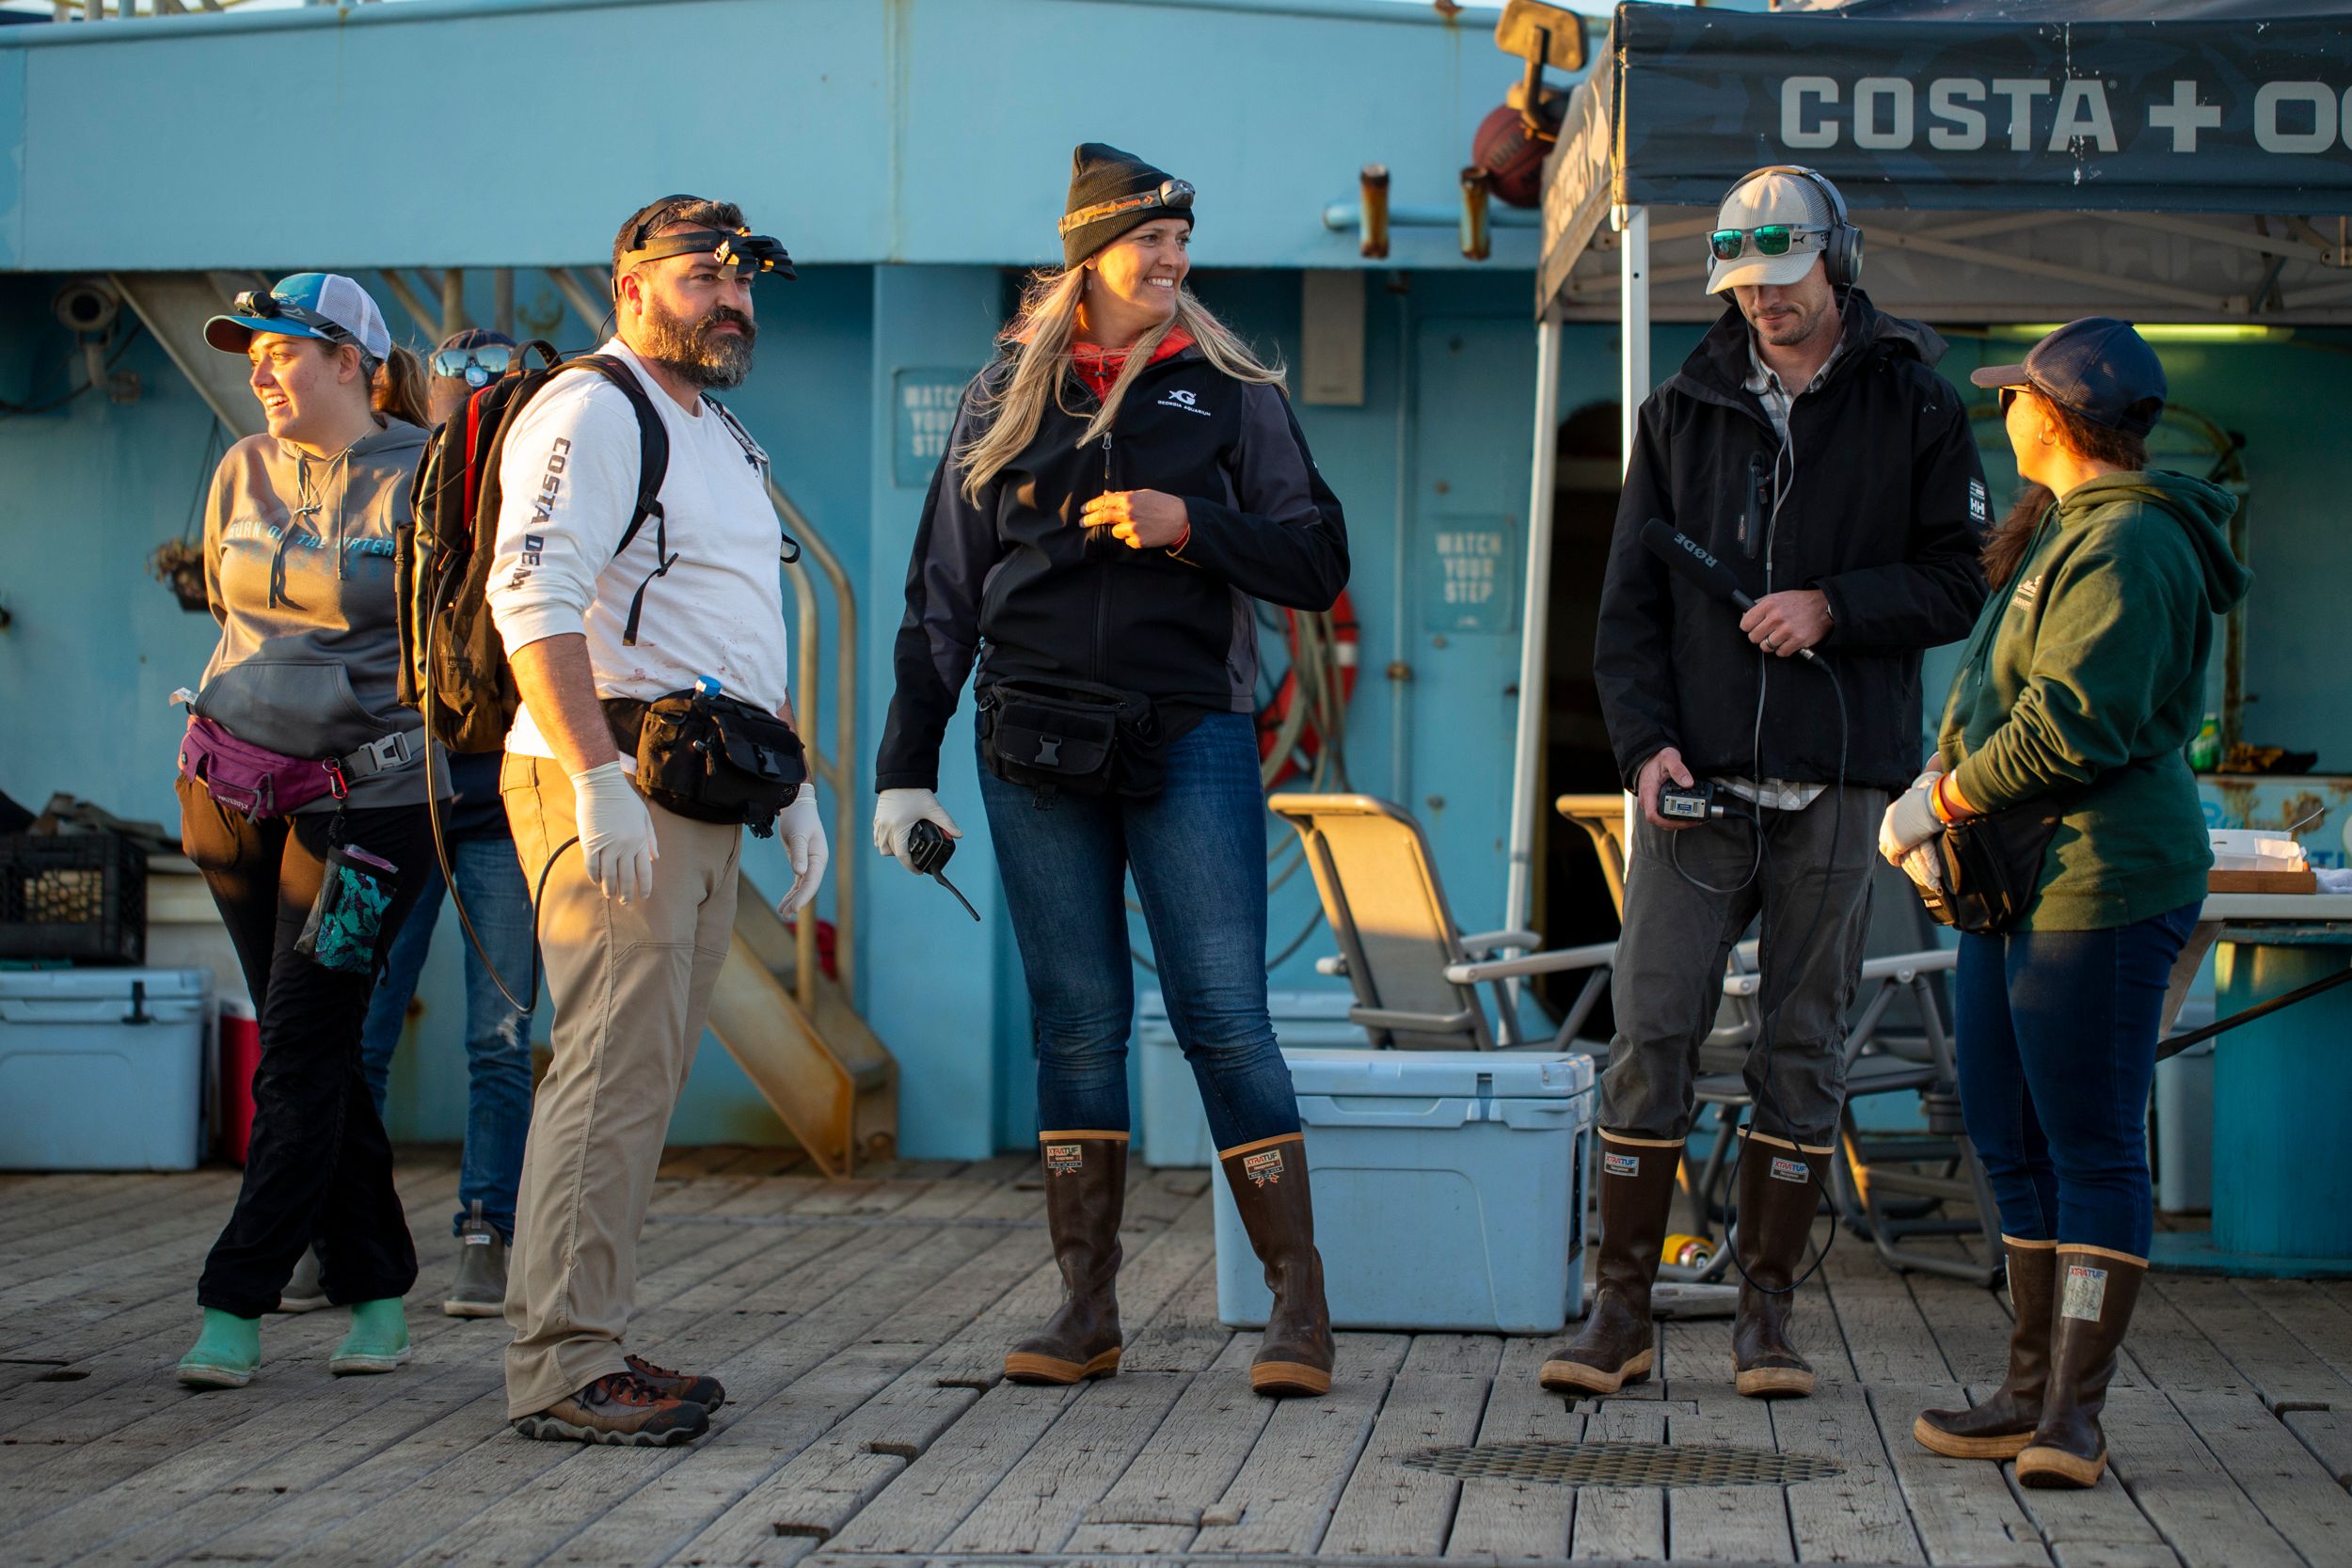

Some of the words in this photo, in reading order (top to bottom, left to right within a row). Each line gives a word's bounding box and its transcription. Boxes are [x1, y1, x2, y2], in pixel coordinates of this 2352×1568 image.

[1781, 75, 2118, 151] COSTA
[905, 385, 963, 407] WATC
[1157, 400, 1183, 408] GEORGIA
[1184, 405, 1212, 417] AQUARIUM
[531, 436, 571, 525] COSTA
[297, 534, 327, 549] THE
[1436, 533, 1502, 556] WATCH
[1445, 558, 1494, 578] YOUR
[1445, 580, 1493, 603] STEP
[1048, 1147, 1080, 1155] XTRATUF
[1246, 1151, 1278, 1165] XTRATUF
[1606, 1155, 1636, 1166] XTRATUF
[1775, 1160, 1806, 1172] XTRATUF
[2071, 1267, 2105, 1279] XTRATUF
